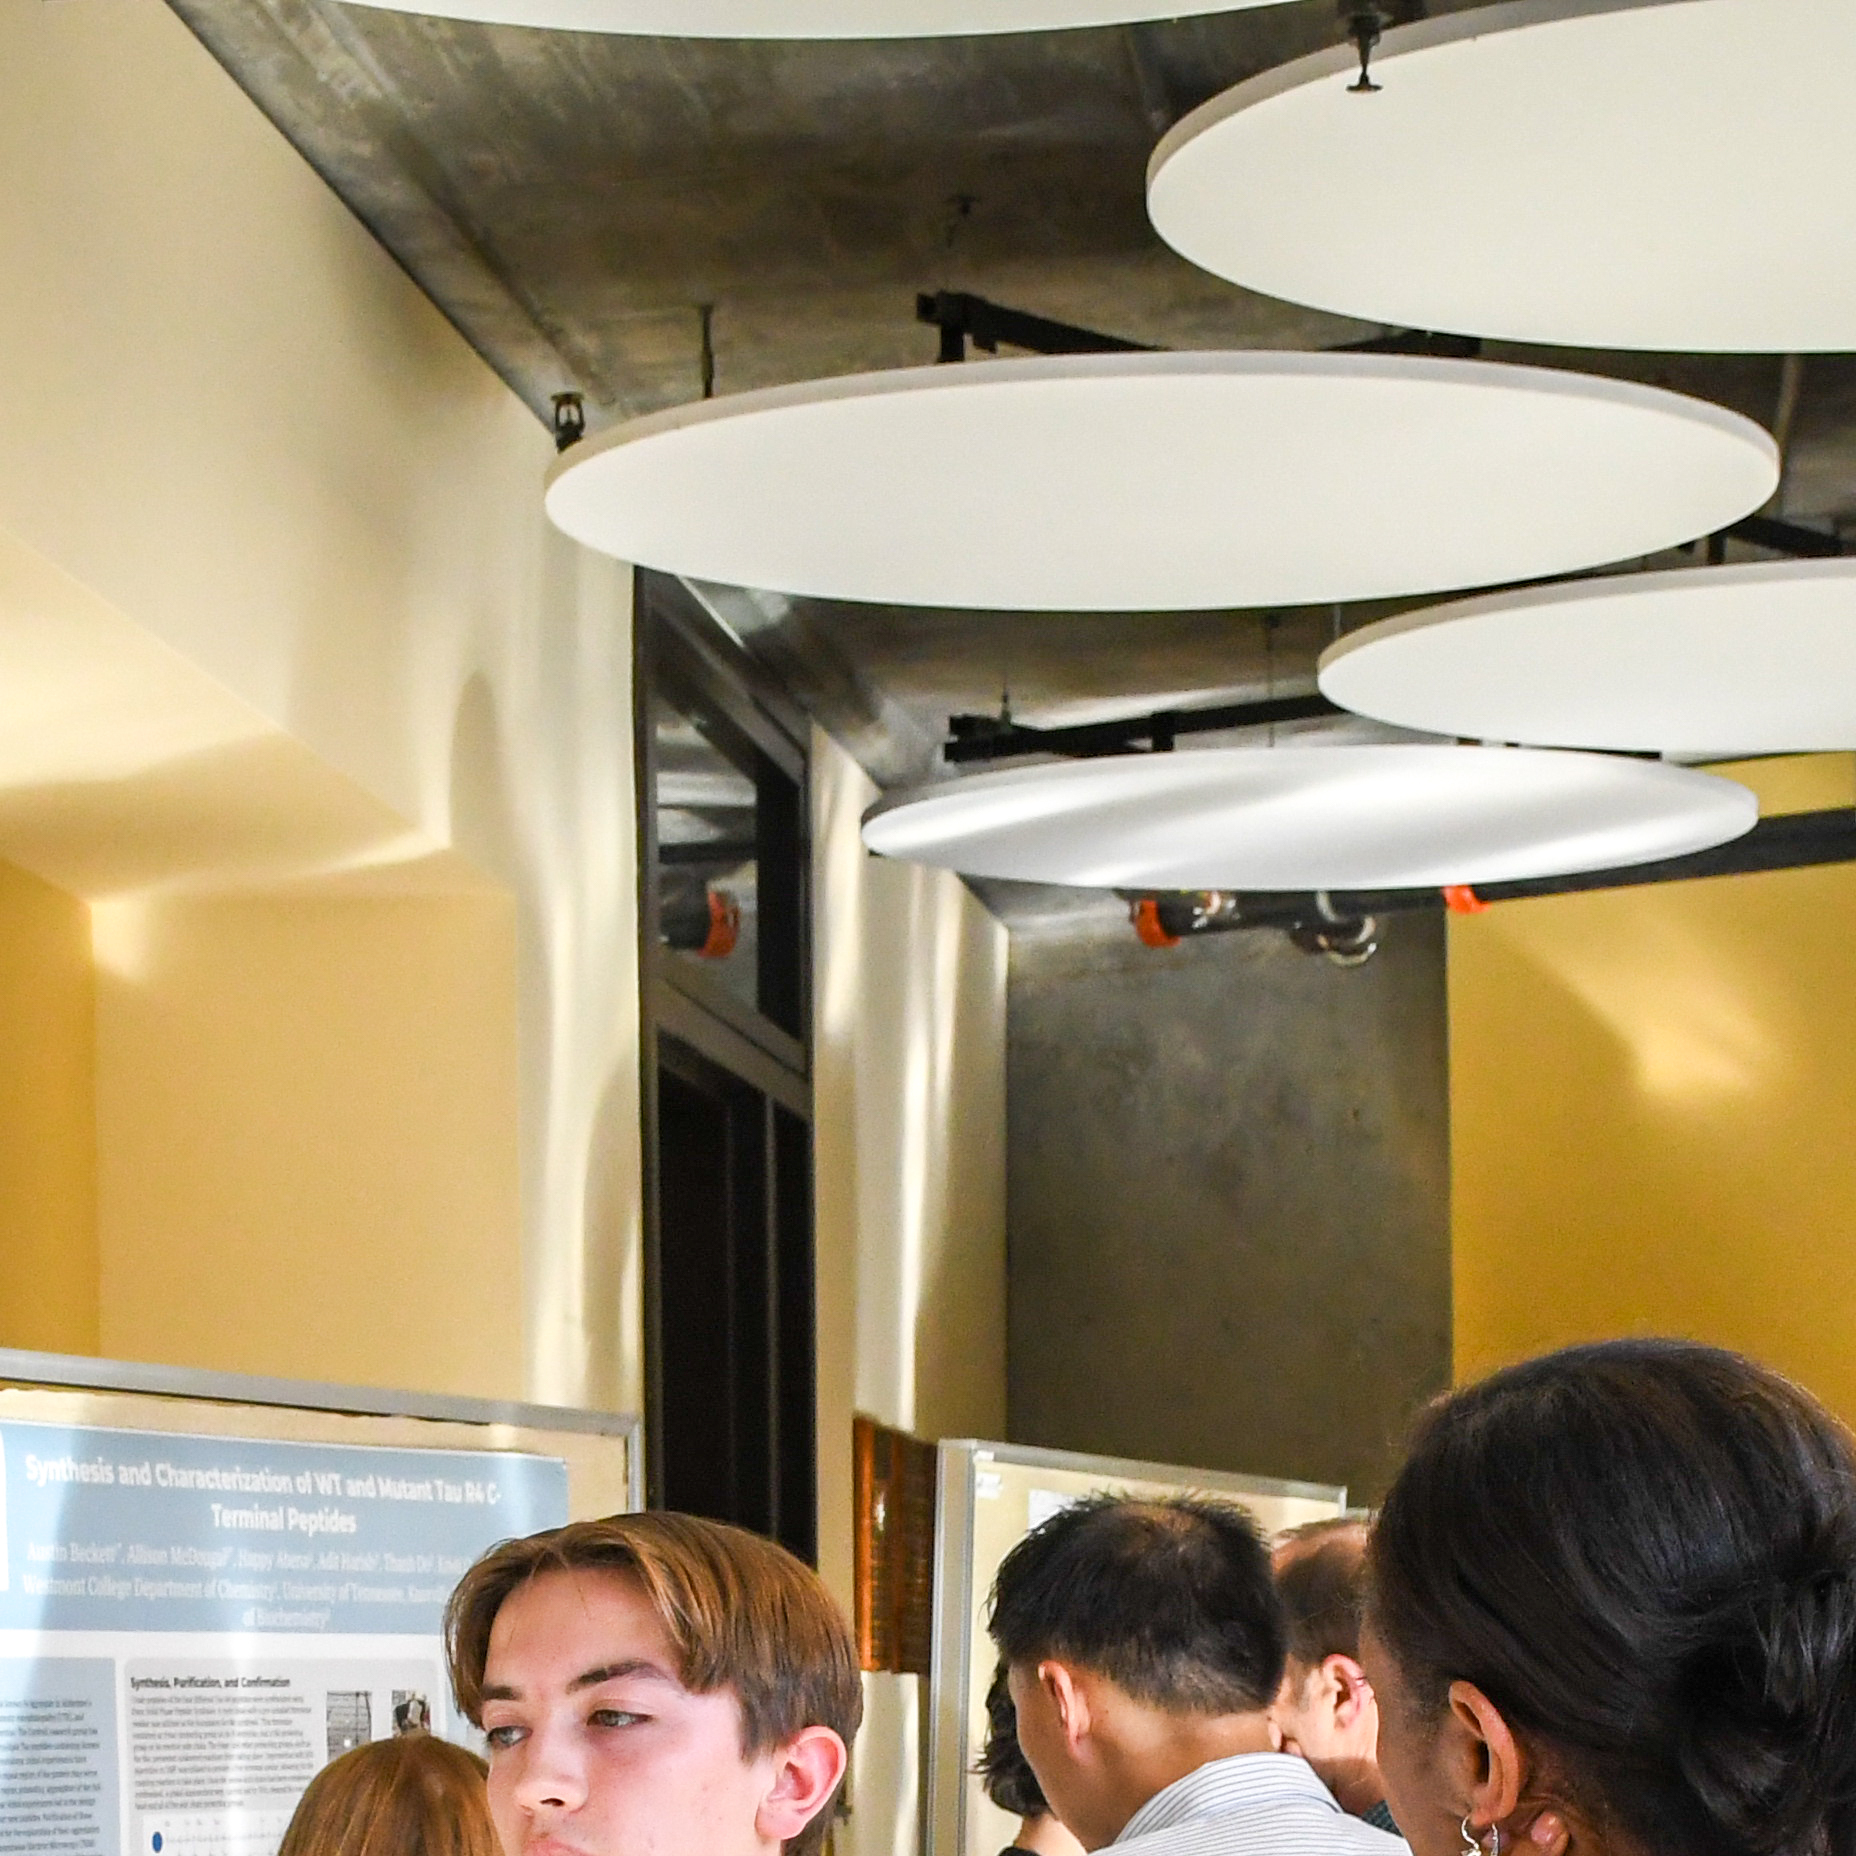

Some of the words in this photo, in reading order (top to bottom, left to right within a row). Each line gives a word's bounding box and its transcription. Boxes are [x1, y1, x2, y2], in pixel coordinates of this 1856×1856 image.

[25, 1454, 114, 1487] Synthesis
[119, 1462, 151, 1486] and
[155, 1462, 293, 1494] Characterization
[296, 1471, 311, 1495] of
[313, 1472, 342, 1496] WT
[346, 1474, 377, 1498] and
[377, 1476, 433, 1501] Mutant
[435, 1480, 462, 1503] Tau
[210, 1502, 285, 1532] Terminal
[287, 1505, 358, 1537] Peptides
[224, 1677, 239, 1688] and
[240, 1675, 291, 1689] Confirmation
